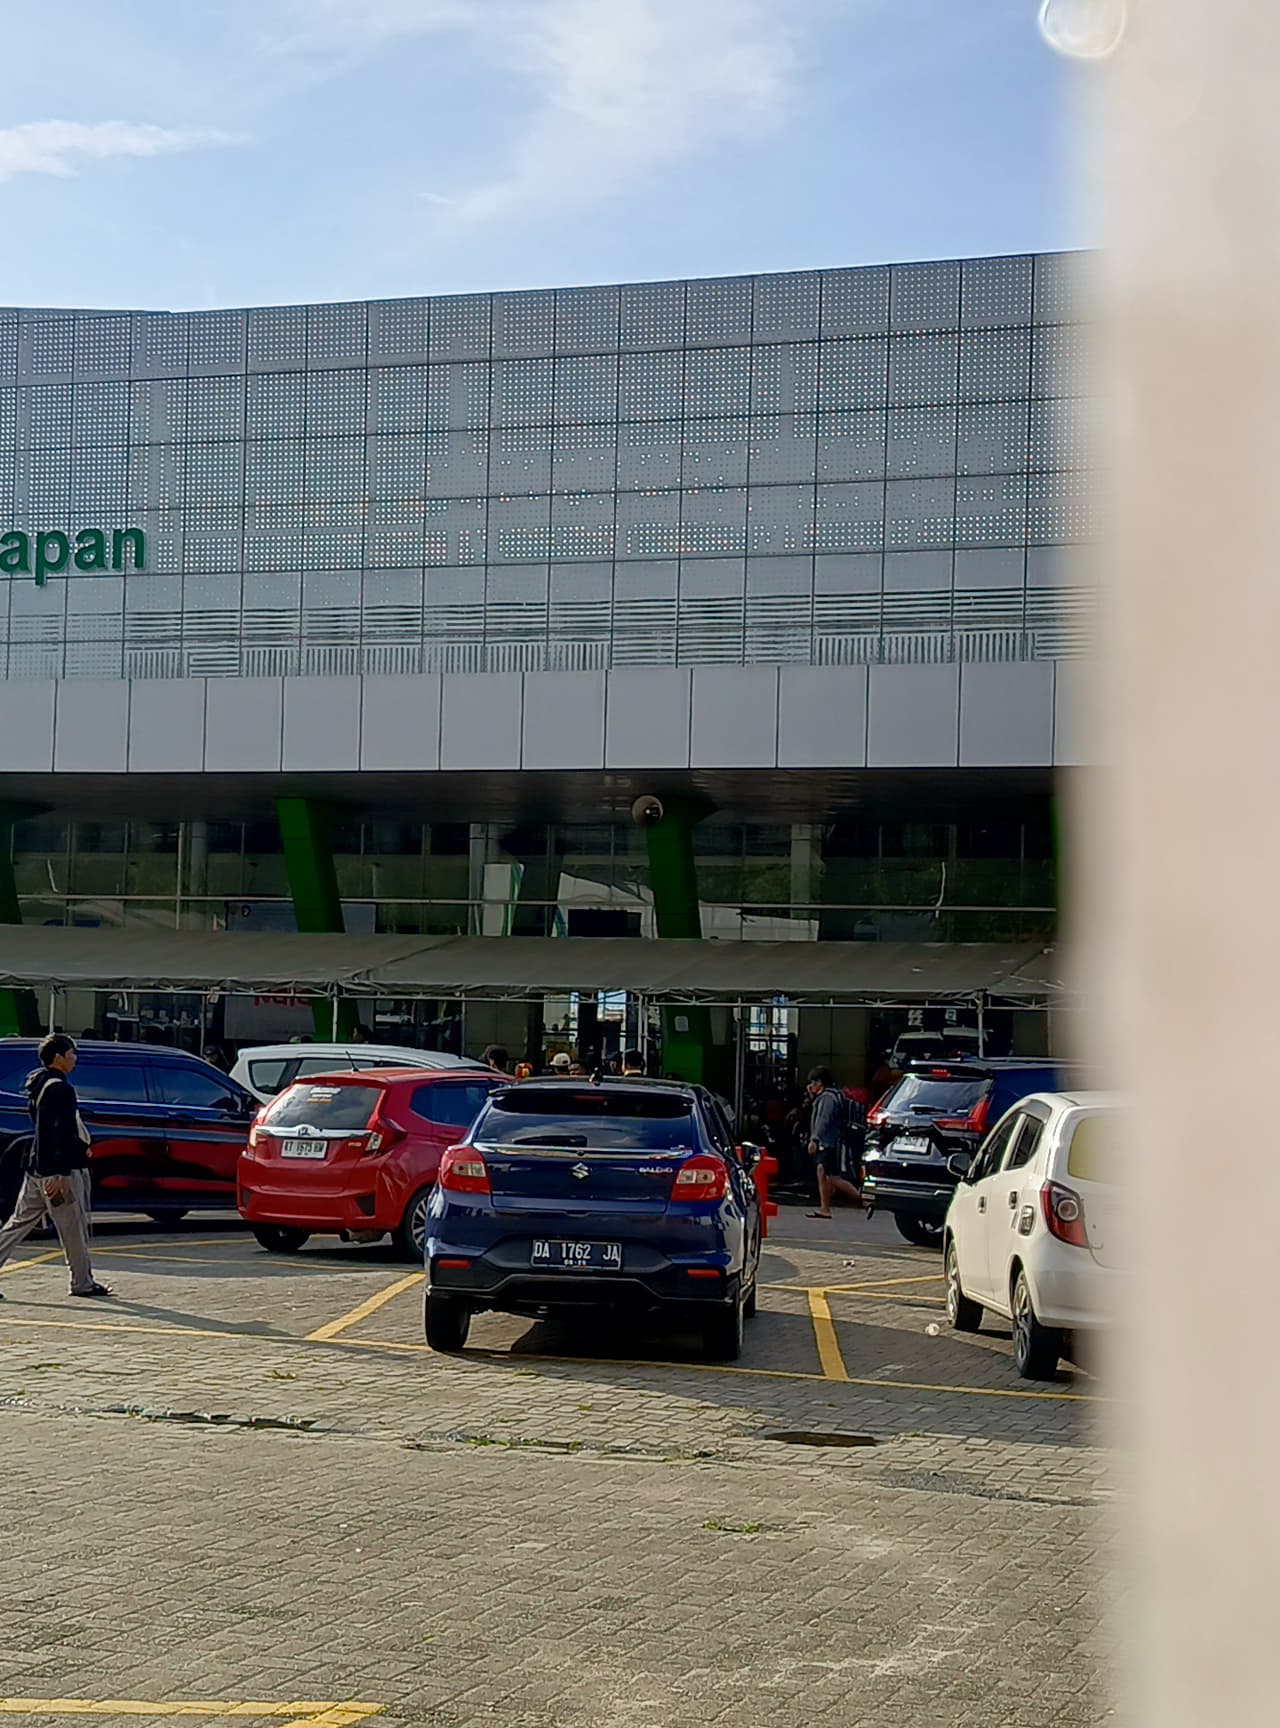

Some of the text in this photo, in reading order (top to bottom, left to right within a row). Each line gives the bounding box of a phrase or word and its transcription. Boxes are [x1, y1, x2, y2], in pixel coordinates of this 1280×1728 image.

[534, 1242, 619, 1260] DA 1762 JA
